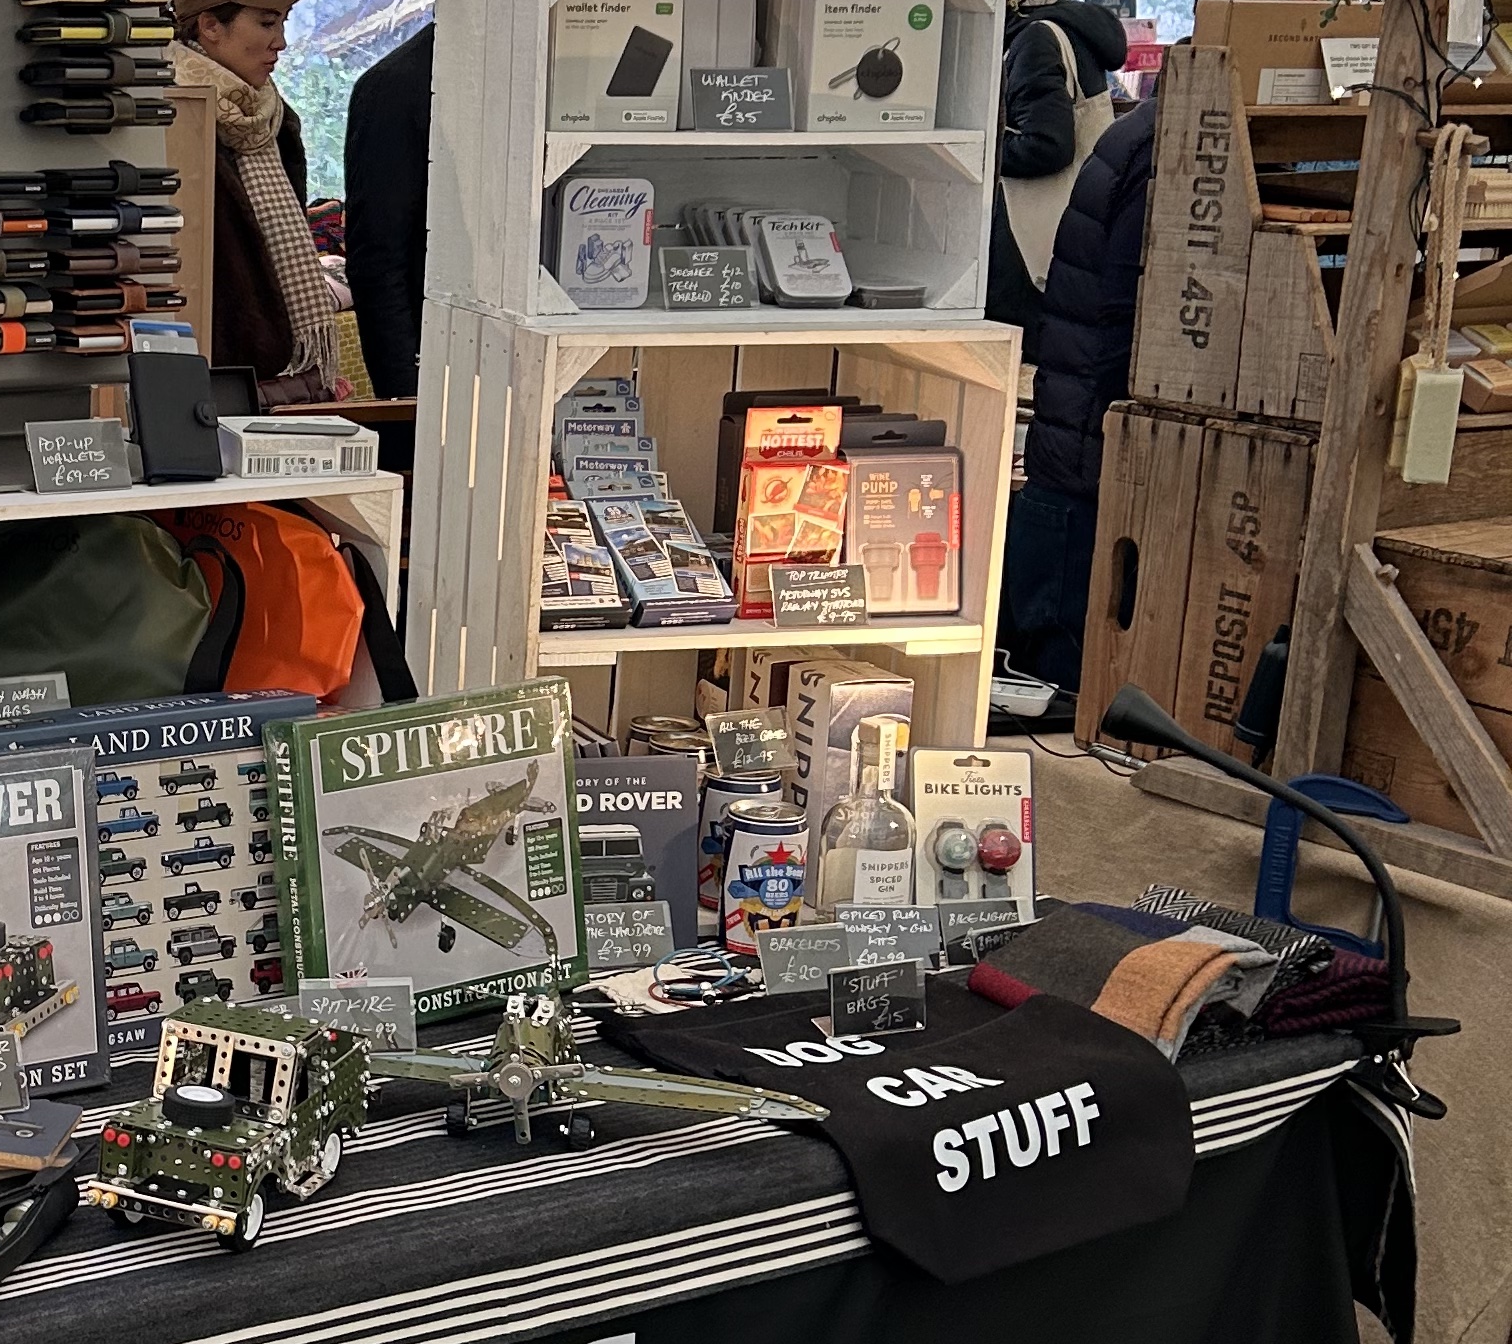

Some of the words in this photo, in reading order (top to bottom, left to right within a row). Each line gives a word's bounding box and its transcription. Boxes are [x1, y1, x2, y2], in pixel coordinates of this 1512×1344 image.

[566, 3, 598, 13] wallet
[600, 3, 631, 13] finder
[824, 4, 848, 13] item
[850, 4, 881, 13] finder
[1268, 34, 1300, 42] SECOND
[702, 74, 768, 87] WALLET
[716, 103, 762, 126] £35
[1188, 109, 1232, 255] DEPOSIT
[570, 185, 648, 219] Cleaning
[767, 221, 798, 232] Tech
[799, 221, 825, 231] Kit
[722, 263, 744, 279] £12
[668, 281, 699, 291] TECH
[719, 276, 742, 294] £10
[719, 290, 744, 307] £10
[1179, 276, 1214, 350] 45P
[567, 422, 615, 432] Motorway
[38, 436, 94, 453] POP-UP
[760, 434, 824, 450] HOTTEST
[43, 451, 106, 465] WALLETS
[579, 460, 628, 471] Motorway
[52, 466, 112, 486] £69-95
[861, 481, 898, 493] PUMP
[1225, 490, 1262, 565] 45P
[786, 570, 806, 581] TOP
[1204, 582, 1253, 726] DEPOSIT
[78, 704, 139, 719] LAND
[145, 696, 218, 711] ROVER
[719, 721, 736, 733] ALL
[740, 719, 762, 731] THE
[69, 726, 150, 757] AND
[160, 715, 254, 748] ROVER
[341, 707, 538, 784] SPITFIRE
[605, 778, 619, 786] OF
[626, 777, 647, 786] THE
[924, 783, 959, 794] BIKE
[965, 784, 1022, 796] LIGHTS
[599, 791, 683, 812] ROVER
[274, 741, 299, 862] SPITFIRE
[288, 877, 301, 914] METAL
[745, 866, 764, 878] All
[861, 862, 909, 872] SNIPPERS
[766, 878, 789, 892] 80
[869, 875, 903, 885] SPICED
[878, 885, 895, 894] GIN
[632, 909, 655, 923] OF
[839, 910, 886, 922] SPICED
[769, 937, 841, 952] BRACELETS
[780, 956, 822, 984] £20
[846, 993, 890, 1015] BAGS
[872, 1007, 911, 1030] £15
[108, 1028, 146, 1045] GSAW
[743, 1035, 887, 1069] DOG
[51, 1061, 89, 1083] SET
[865, 1063, 1005, 1108] CAR
[931, 1083, 1101, 1193] STUFF
